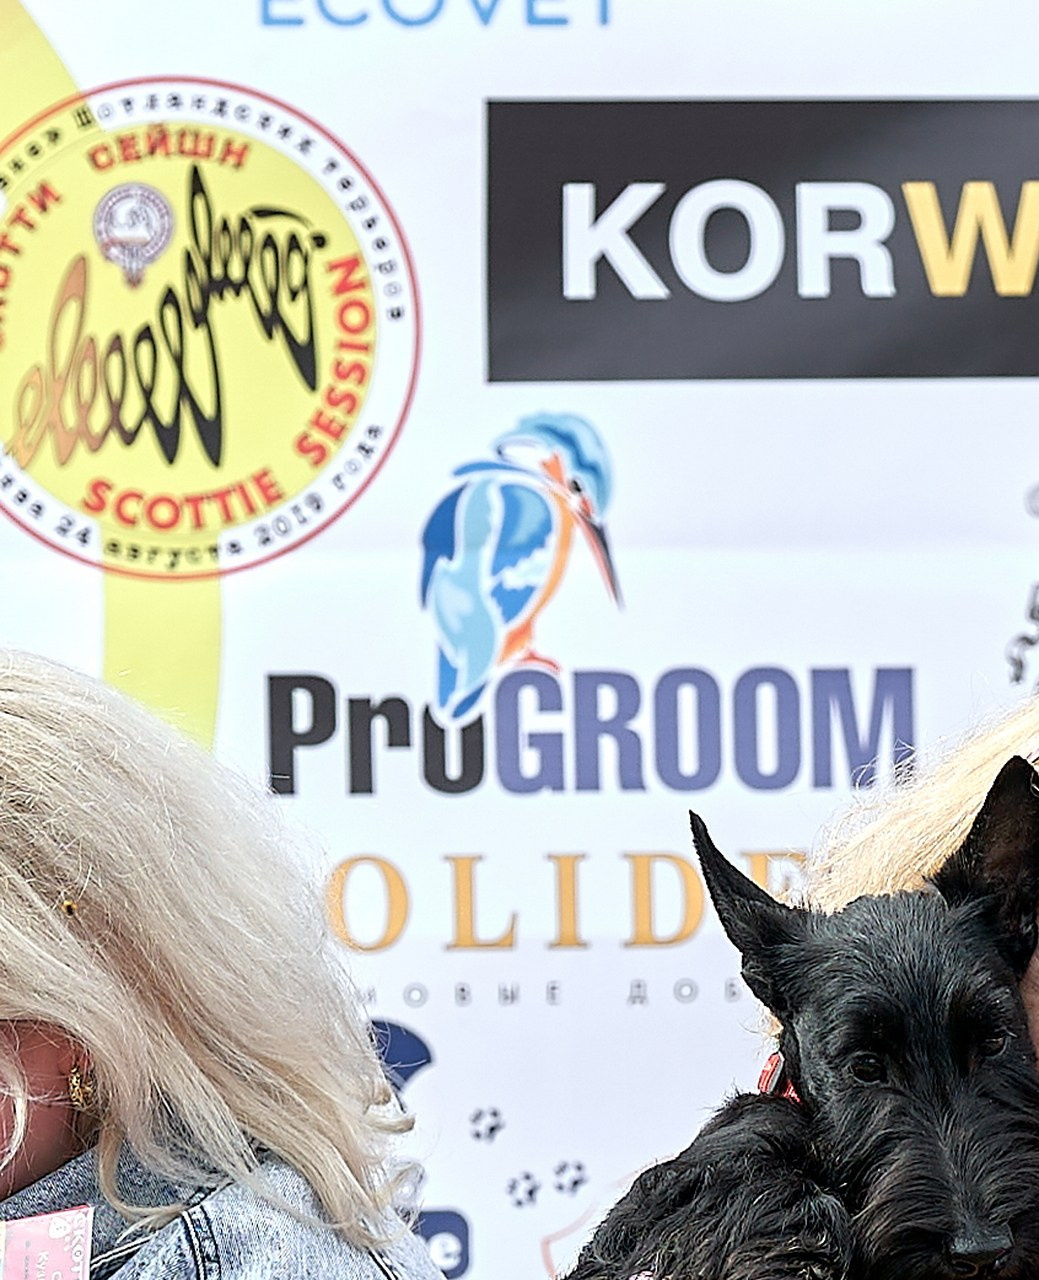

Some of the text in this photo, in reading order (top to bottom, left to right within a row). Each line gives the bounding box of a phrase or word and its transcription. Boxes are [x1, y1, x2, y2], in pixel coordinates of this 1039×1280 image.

[87, 122, 250, 172] СЕЙШН
[81, 254, 372, 531] SCOTTIE SESSION
[54, 513, 93, 547] 24
[104, 538, 243, 570] августа
[253, 491, 325, 547] 2019
[331, 424, 384, 491] года
[265, 665, 917, 796] ProGROOM
